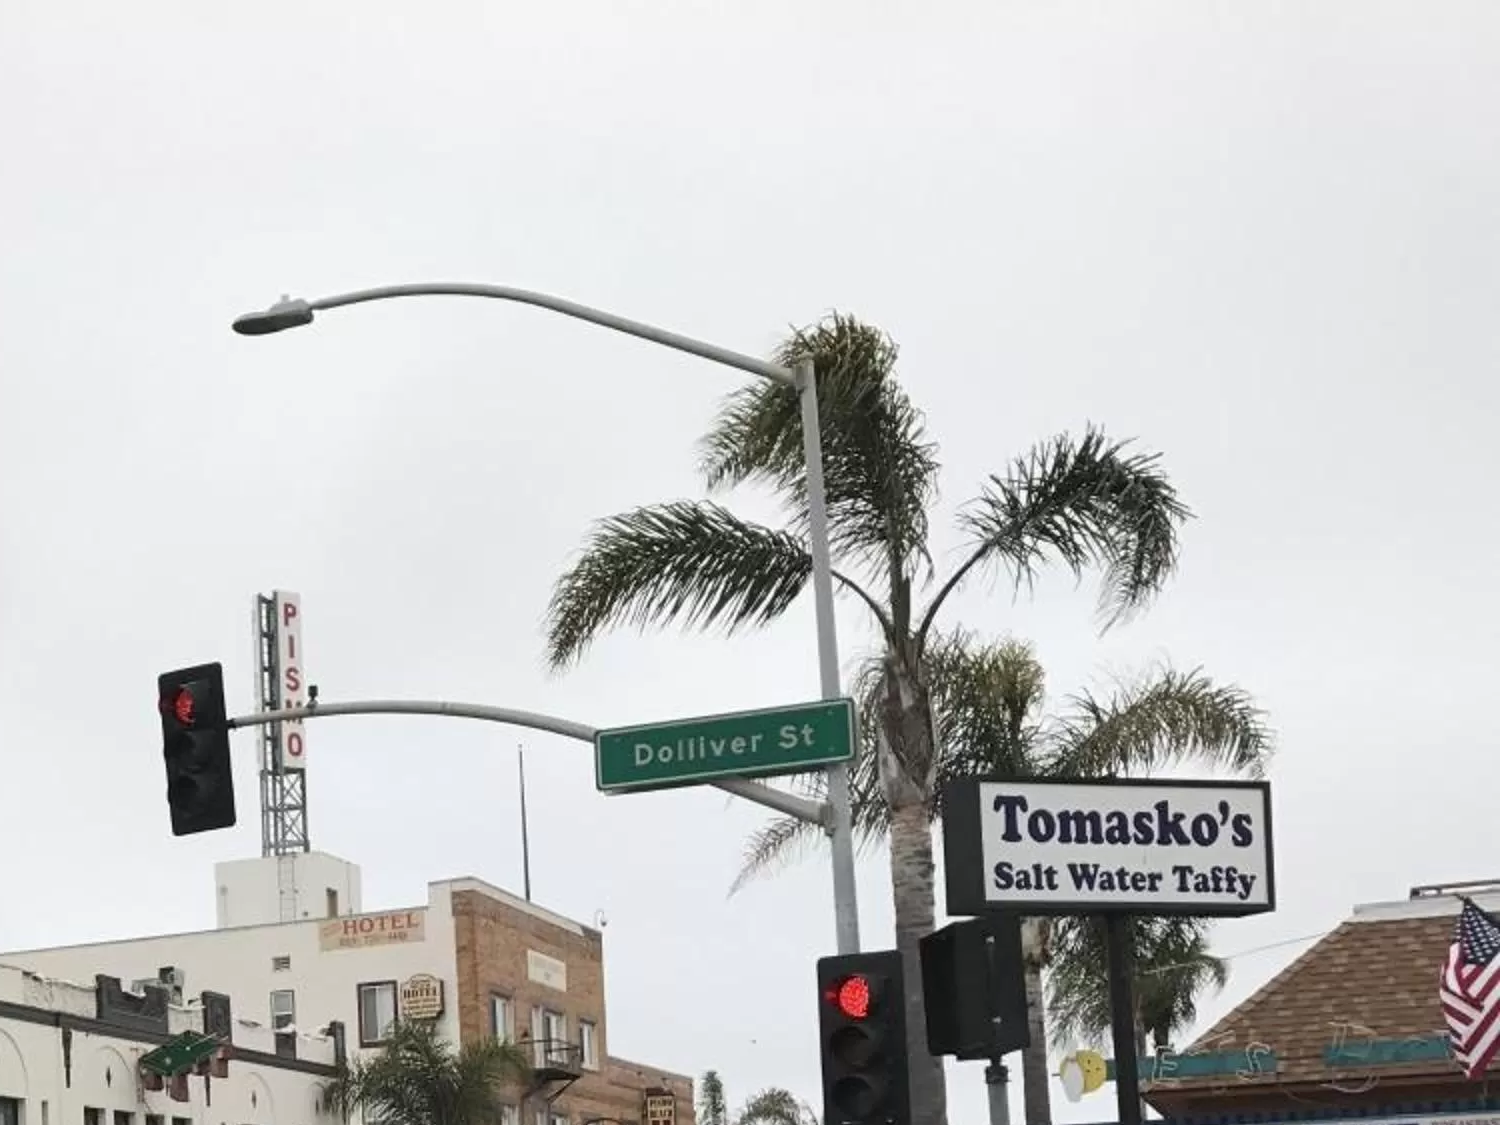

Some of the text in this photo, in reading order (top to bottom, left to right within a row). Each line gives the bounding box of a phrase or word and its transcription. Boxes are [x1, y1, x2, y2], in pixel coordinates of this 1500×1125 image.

[634, 723, 815, 767] Dolliver St
[993, 795, 1253, 848] Tomasko's
[993, 861, 1257, 900] Salt Water Taffy
[342, 912, 420, 935] HOTEL
